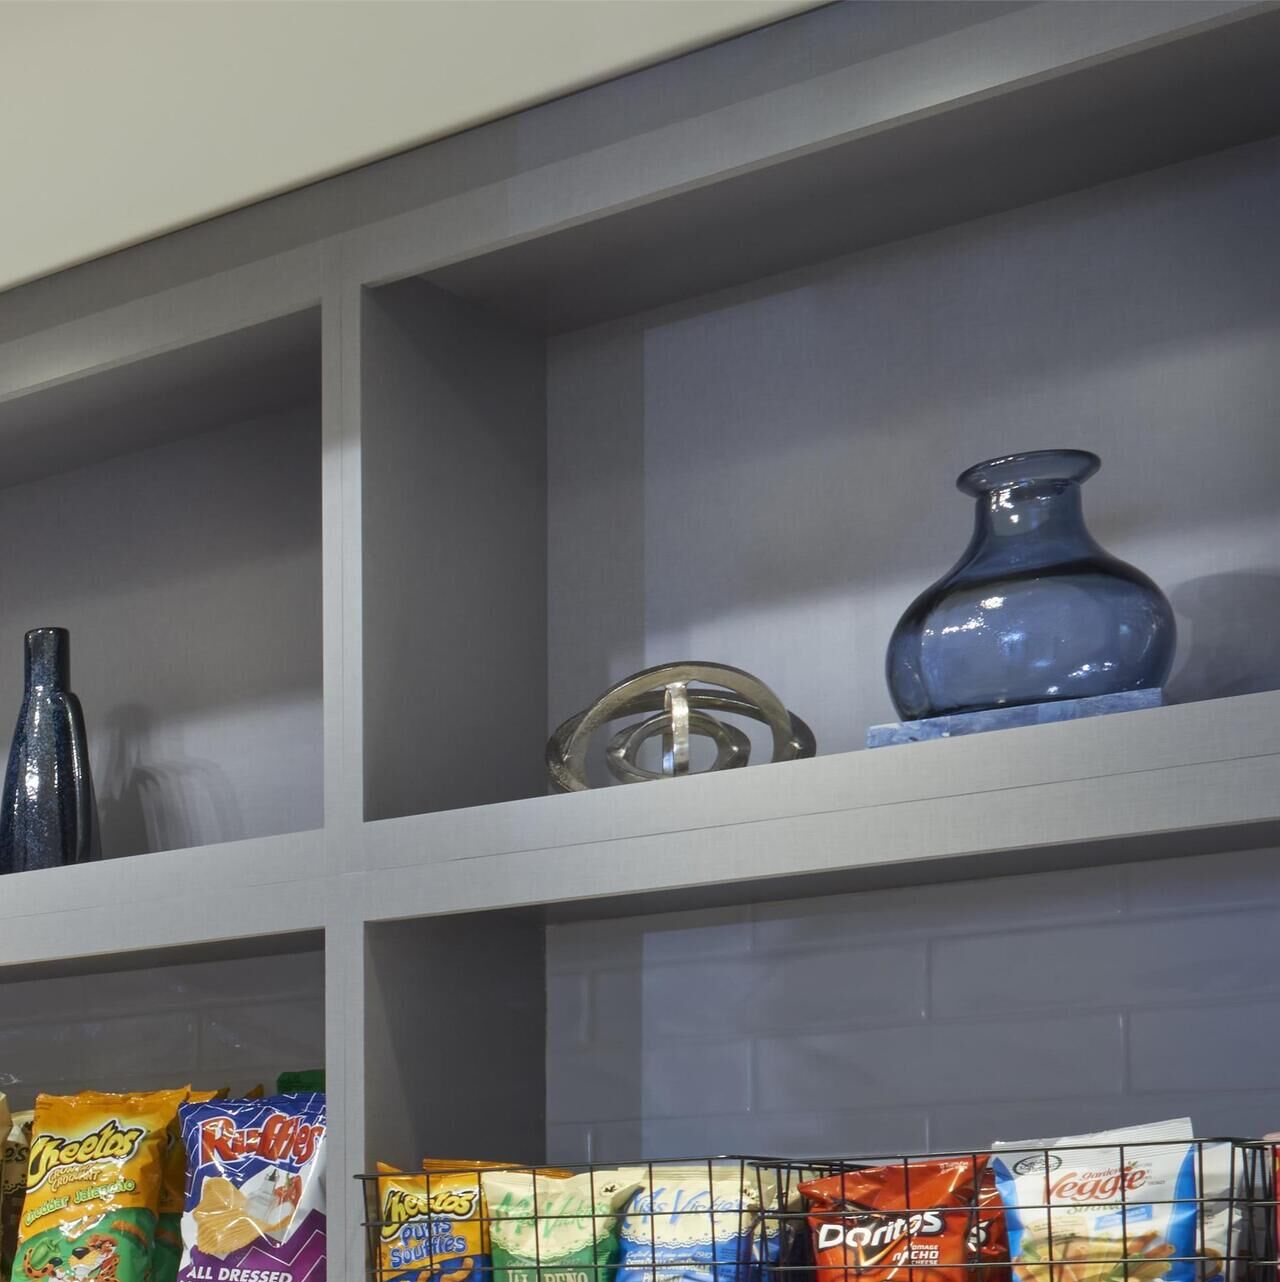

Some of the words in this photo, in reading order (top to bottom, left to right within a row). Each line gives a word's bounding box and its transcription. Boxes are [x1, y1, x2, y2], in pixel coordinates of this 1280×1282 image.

[26, 1120, 144, 1189] Cheetos
[200, 1115, 326, 1166] Ruffles
[1044, 1167, 1147, 1205] Veggie
[381, 1190, 479, 1239] Cheetos
[819, 1211, 942, 1248] Doritos
[186, 1266, 214, 1280] ALL
